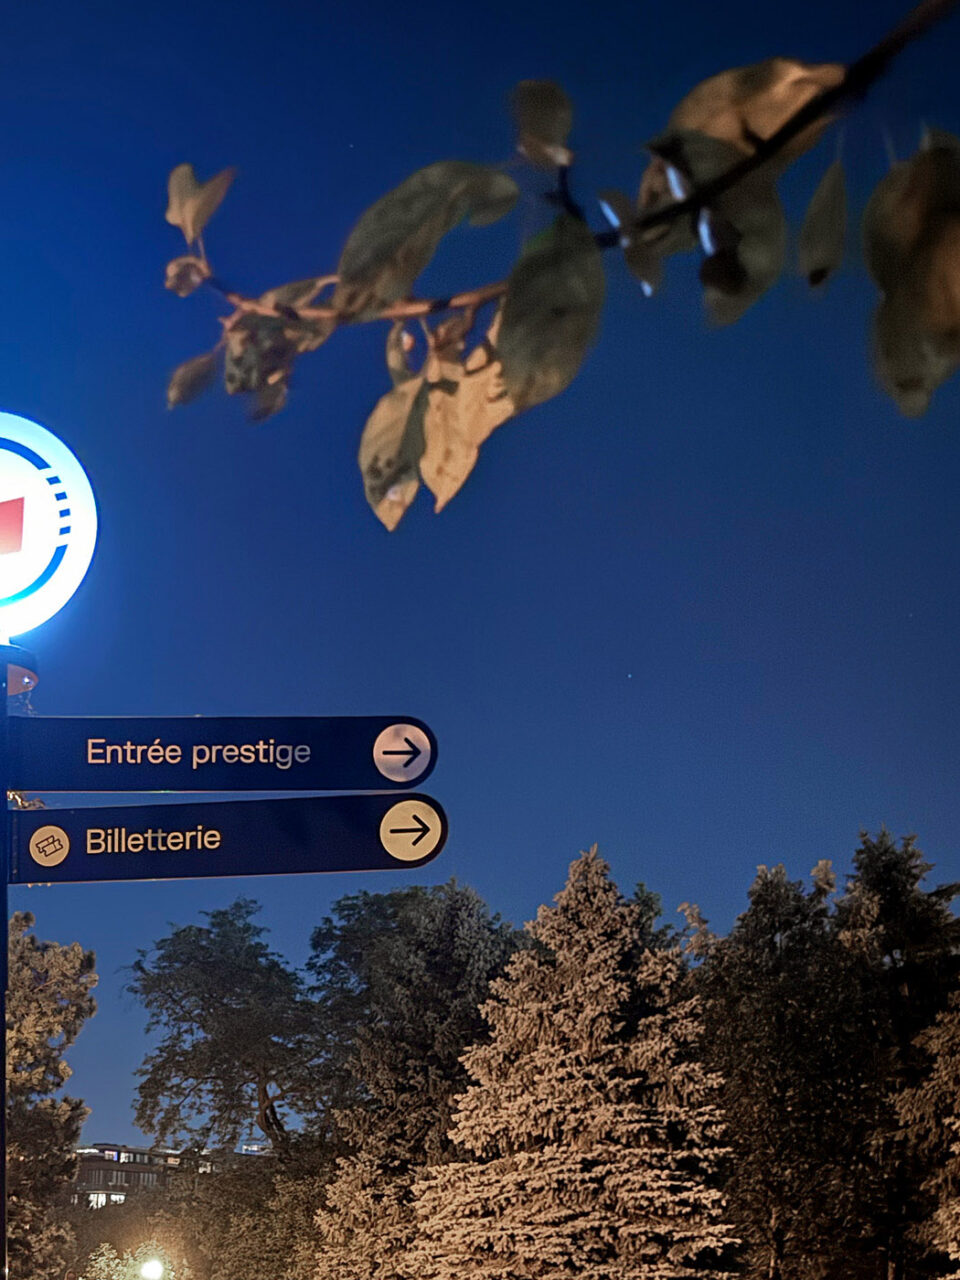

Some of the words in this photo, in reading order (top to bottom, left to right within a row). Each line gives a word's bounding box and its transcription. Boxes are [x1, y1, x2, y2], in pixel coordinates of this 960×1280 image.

[87, 738, 182, 764] Entrée
[192, 738, 311, 770] prestige
[86, 825, 221, 854] Billetterie
